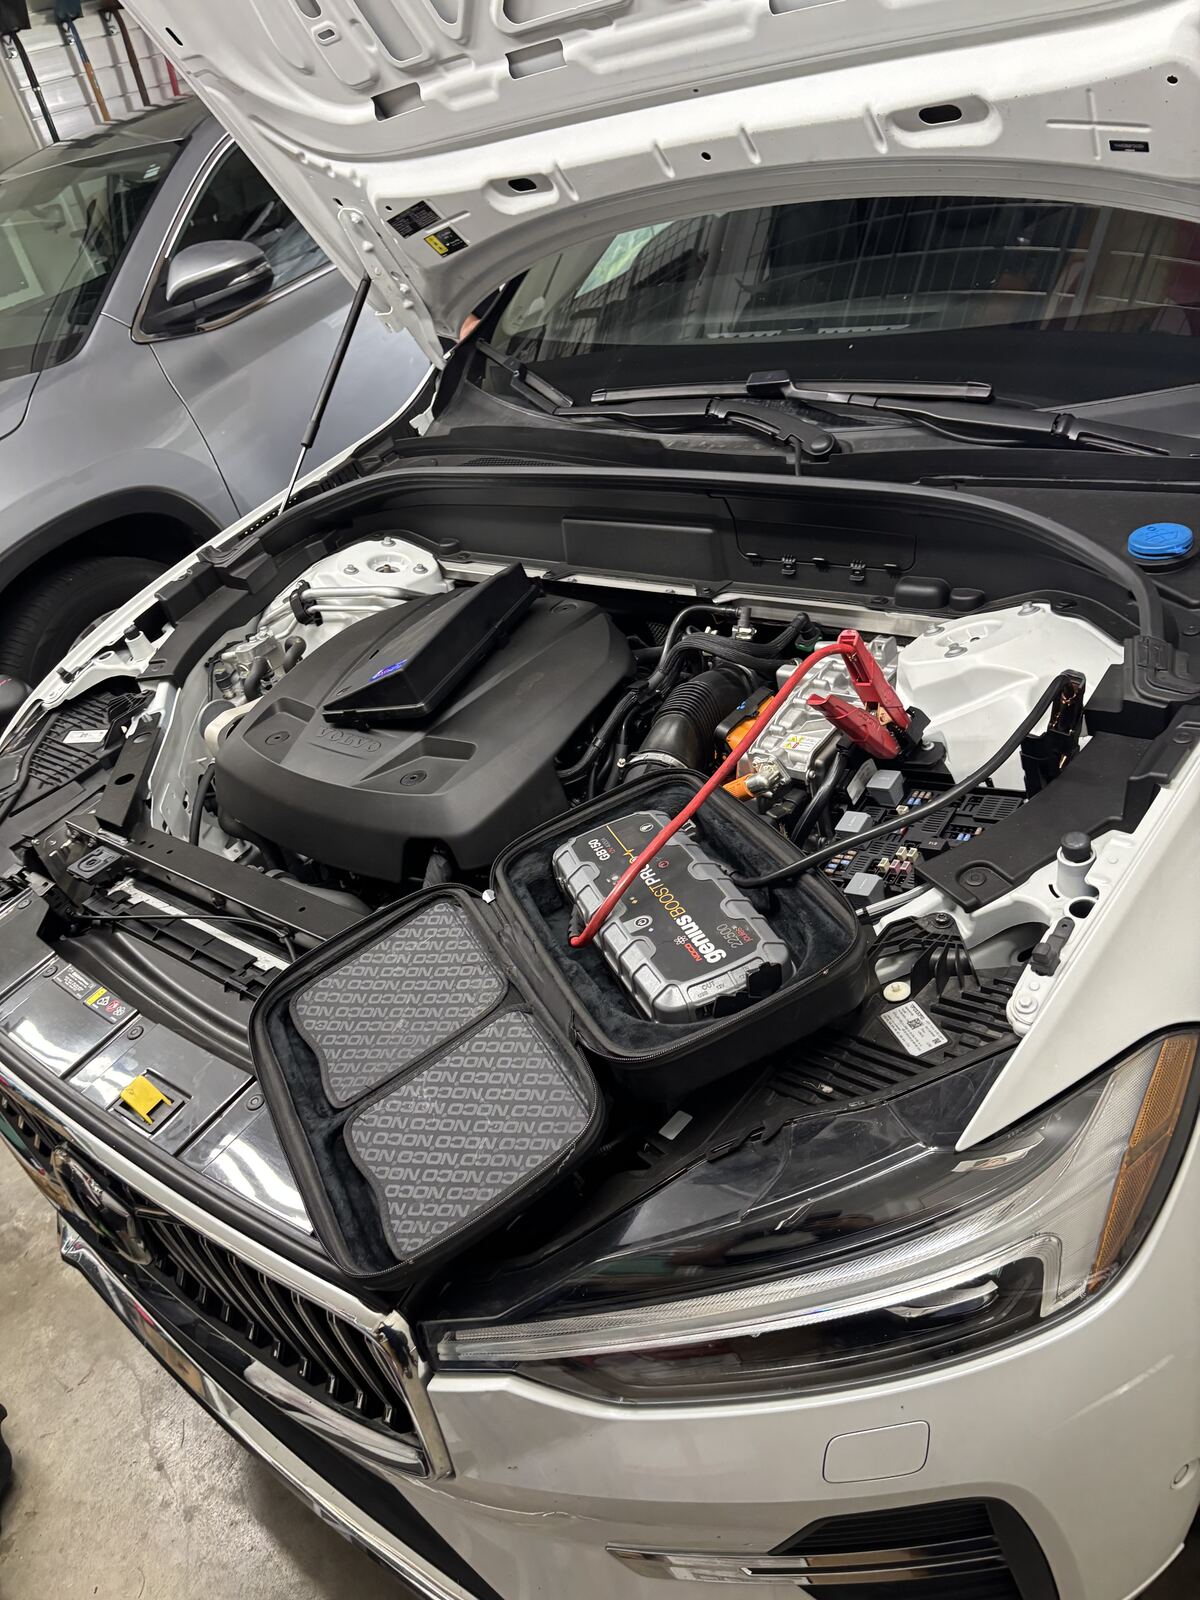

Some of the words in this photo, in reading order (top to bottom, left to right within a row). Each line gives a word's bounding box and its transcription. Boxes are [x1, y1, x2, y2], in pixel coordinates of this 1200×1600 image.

[317, 728, 382, 753] VOLVO
[588, 839, 610, 861] GB150
[717, 924, 743, 948] 22500
[392, 940, 444, 951] NOCO
[684, 943, 702, 961] NOCO
[359, 953, 412, 964] NOCO
[413, 953, 465, 964] NOCO
[380, 966, 433, 977] NOCO
[348, 979, 400, 991] NOCO
[401, 980, 454, 991] NOCO
[701, 981, 715, 991] OUT
[313, 992, 367, 1004] NOCO
[368, 993, 421, 1004] NOCO
[422, 993, 476, 1004] NOCO
[334, 1007, 388, 1017] NOCO
[389, 1007, 443, 1018] NOCO
[321, 1034, 375, 1045] NOCO
[376, 1034, 431, 1046] NOCO
[471, 1041, 531, 1053] NOCO
[341, 1048, 396, 1059] NOCO
[460, 1072, 520, 1084] NOCO
[424, 1086, 484, 1099] NOCO
[484, 1088, 547, 1102] NOCO
[385, 1100, 446, 1115] NOCO
[448, 1103, 510, 1117] NOCO
[511, 1105, 575, 1117] NOCO
[409, 1118, 472, 1132] NOCO
[473, 1120, 536, 1133] NOCO
[372, 1132, 433, 1147] NOCO
[434, 1135, 498, 1150] NOCO
[499, 1138, 563, 1151] NOCO
[397, 1151, 459, 1165] NOCO
[460, 1153, 524, 1167] NOCO
[421, 1169, 484, 1183] NOCO
[385, 1184, 445, 1199] NOCO
[405, 1203, 470, 1218] NOCO
